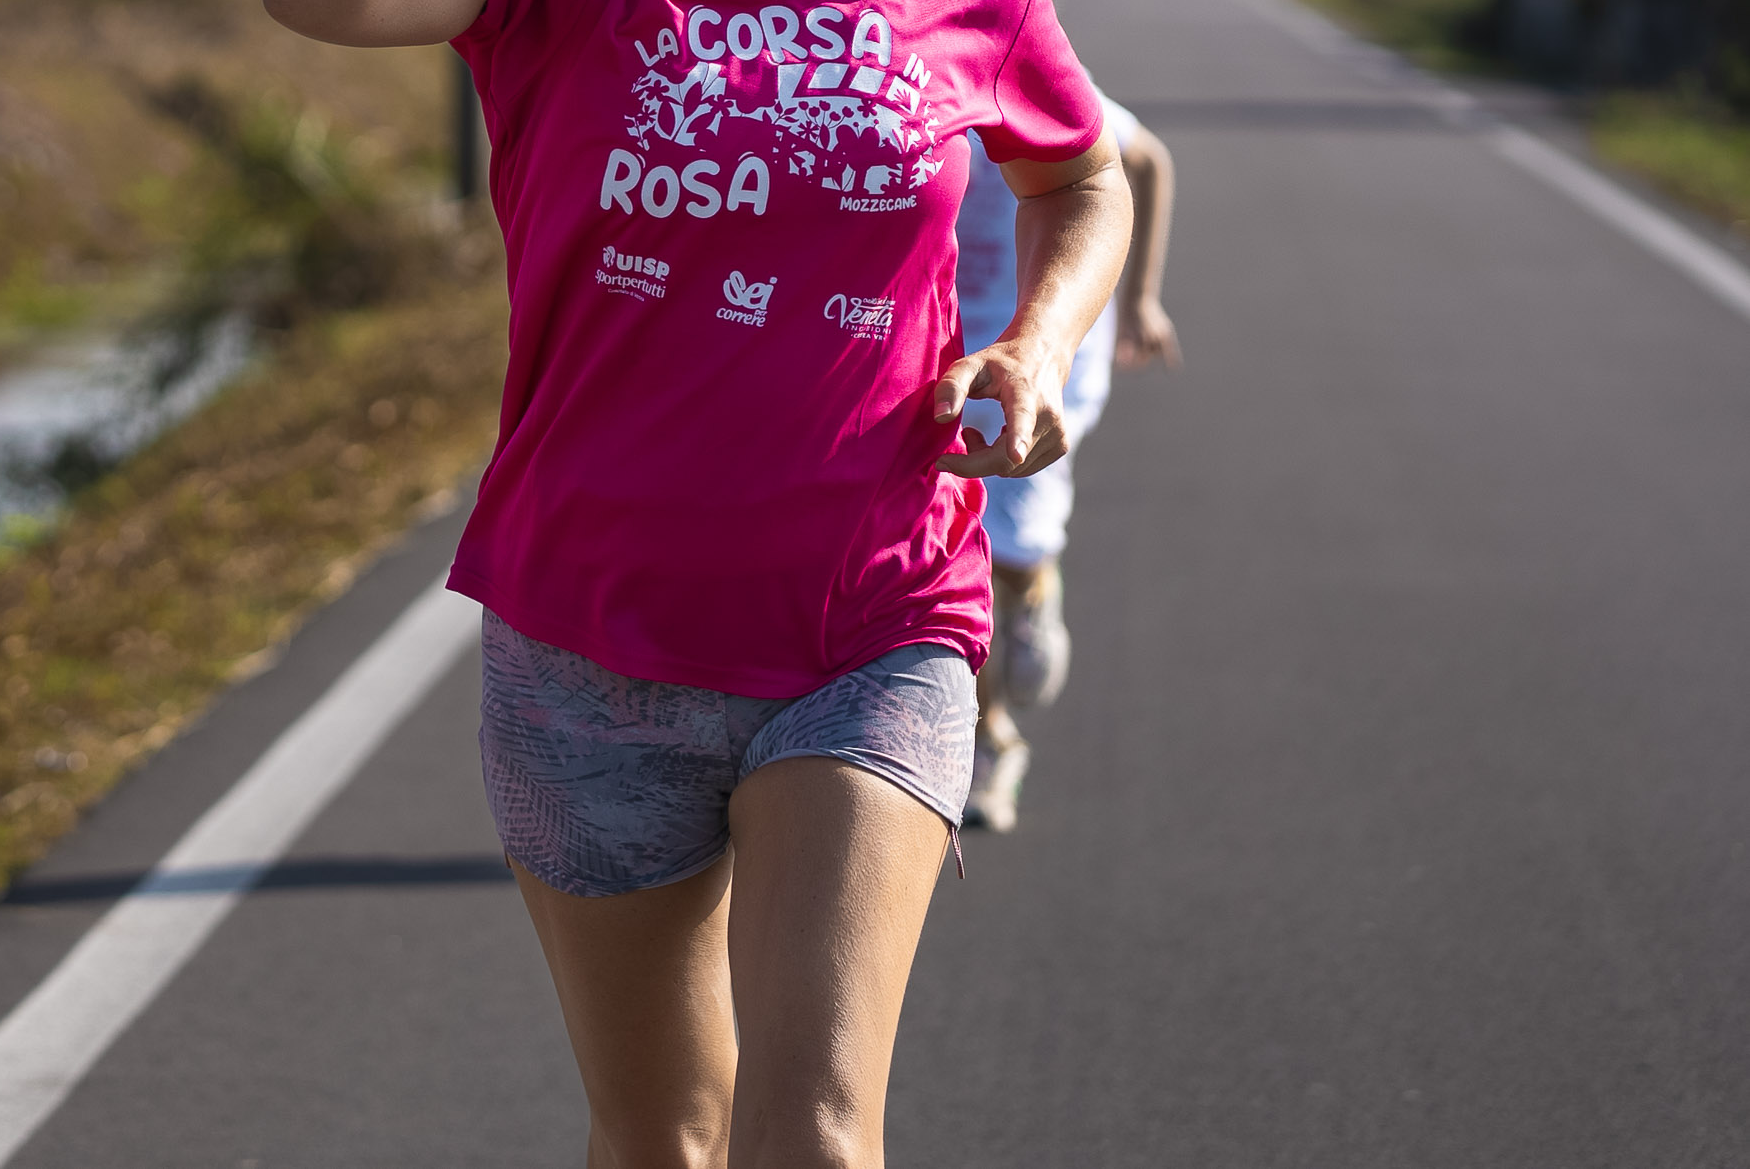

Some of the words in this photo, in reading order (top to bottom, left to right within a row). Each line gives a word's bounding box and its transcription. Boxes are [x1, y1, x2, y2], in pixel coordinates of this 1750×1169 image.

[634, 27, 679, 67] LA
[686, 4, 892, 67] CORSA
[903, 53, 932, 90] IN
[599, 148, 770, 219] ROSA
[839, 194, 918, 213] MOZZECANE
[595, 269, 667, 299] sportpertutti
[723, 270, 778, 310] Sei
[716, 307, 766, 328] correre
[823, 293, 893, 329] Veneta
